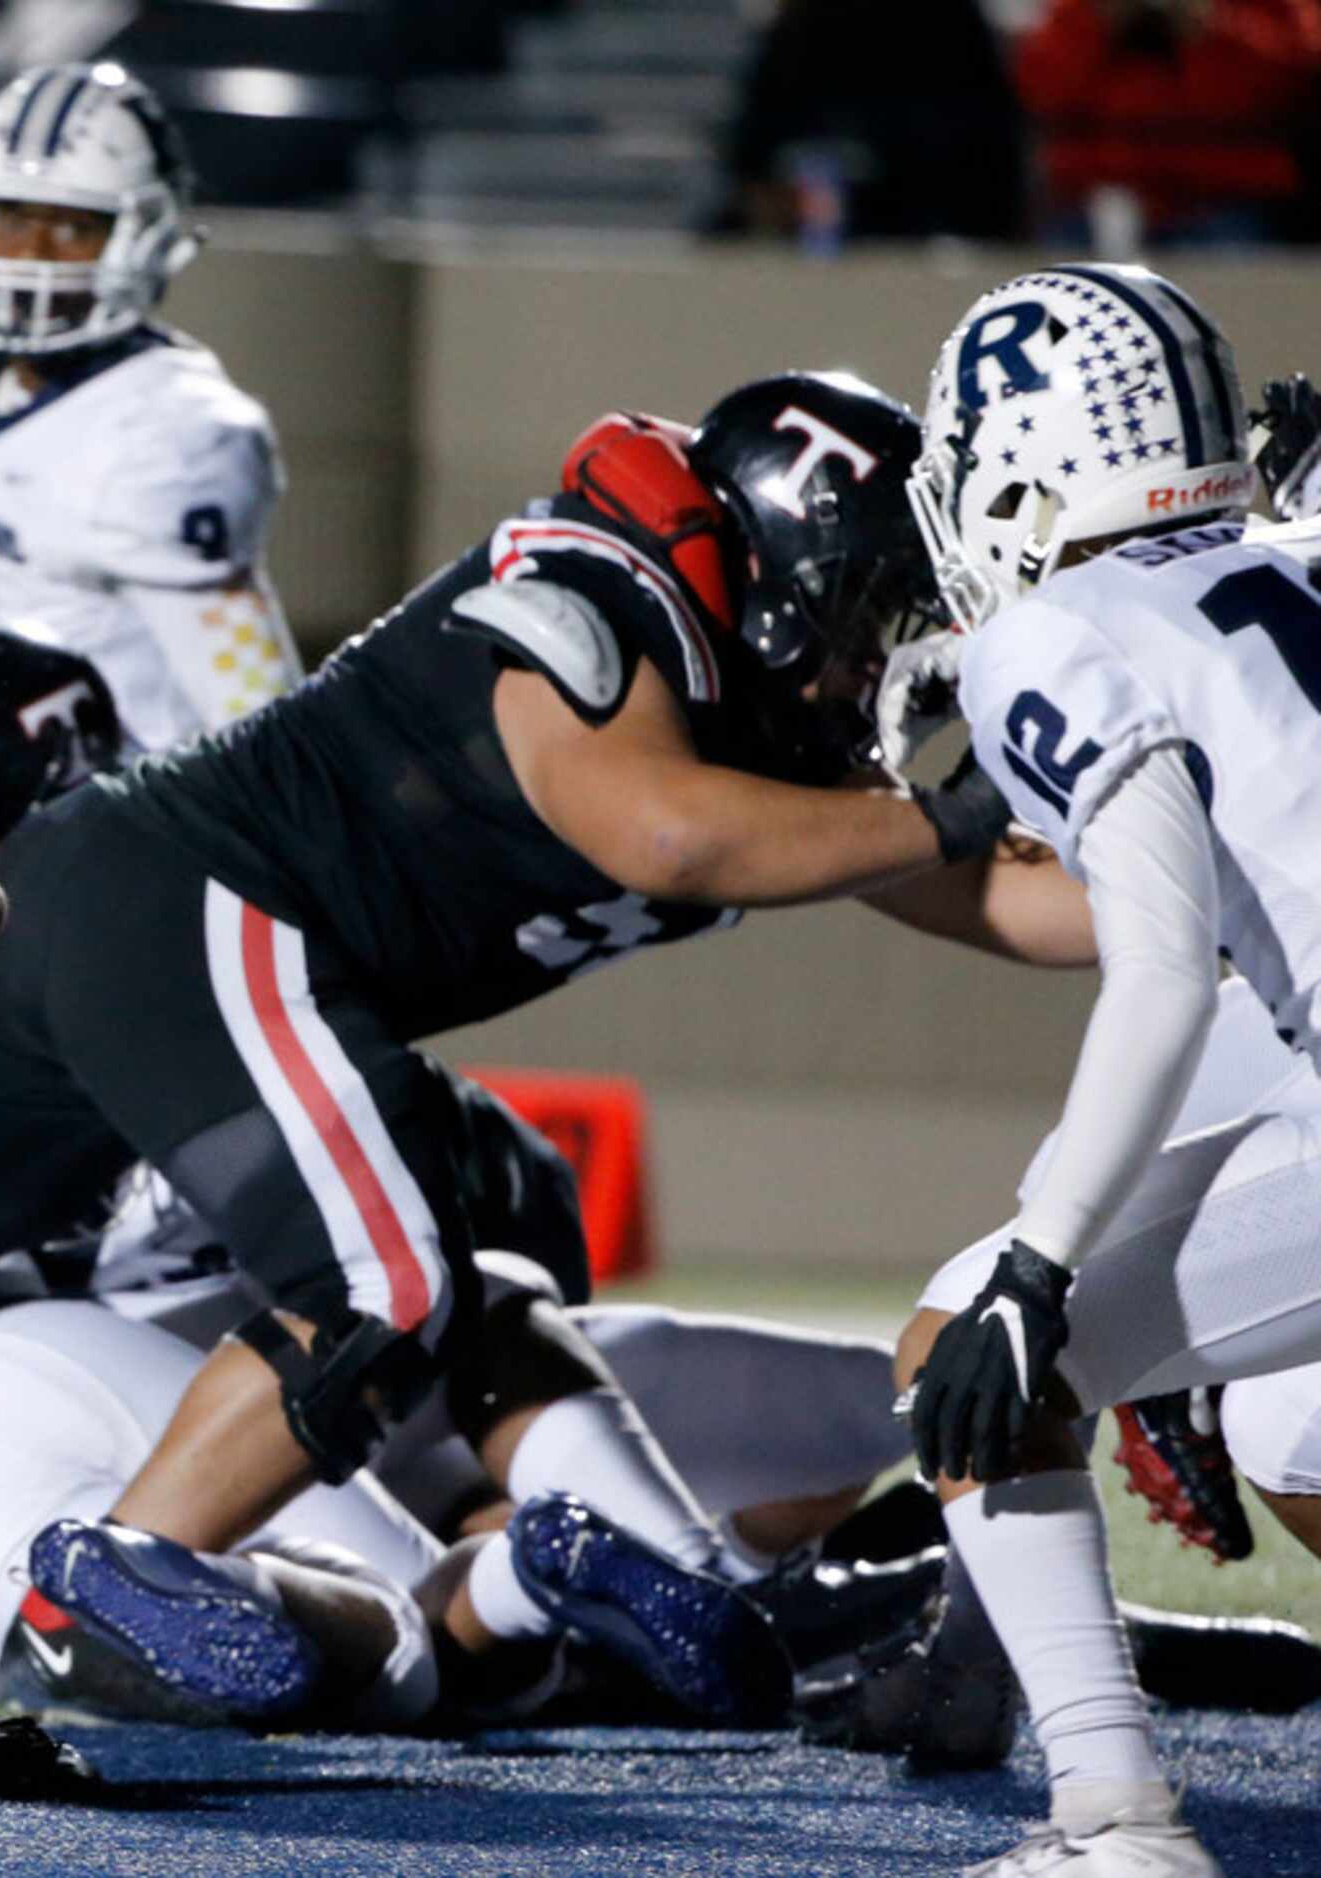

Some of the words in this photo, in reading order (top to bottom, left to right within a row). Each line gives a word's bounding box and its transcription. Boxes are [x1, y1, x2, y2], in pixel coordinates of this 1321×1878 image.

[957, 300, 1052, 413] R
[756, 405, 882, 521] T
[182, 503, 230, 562] 9
[16, 678, 96, 789] T
[1001, 689, 1106, 824] 12
